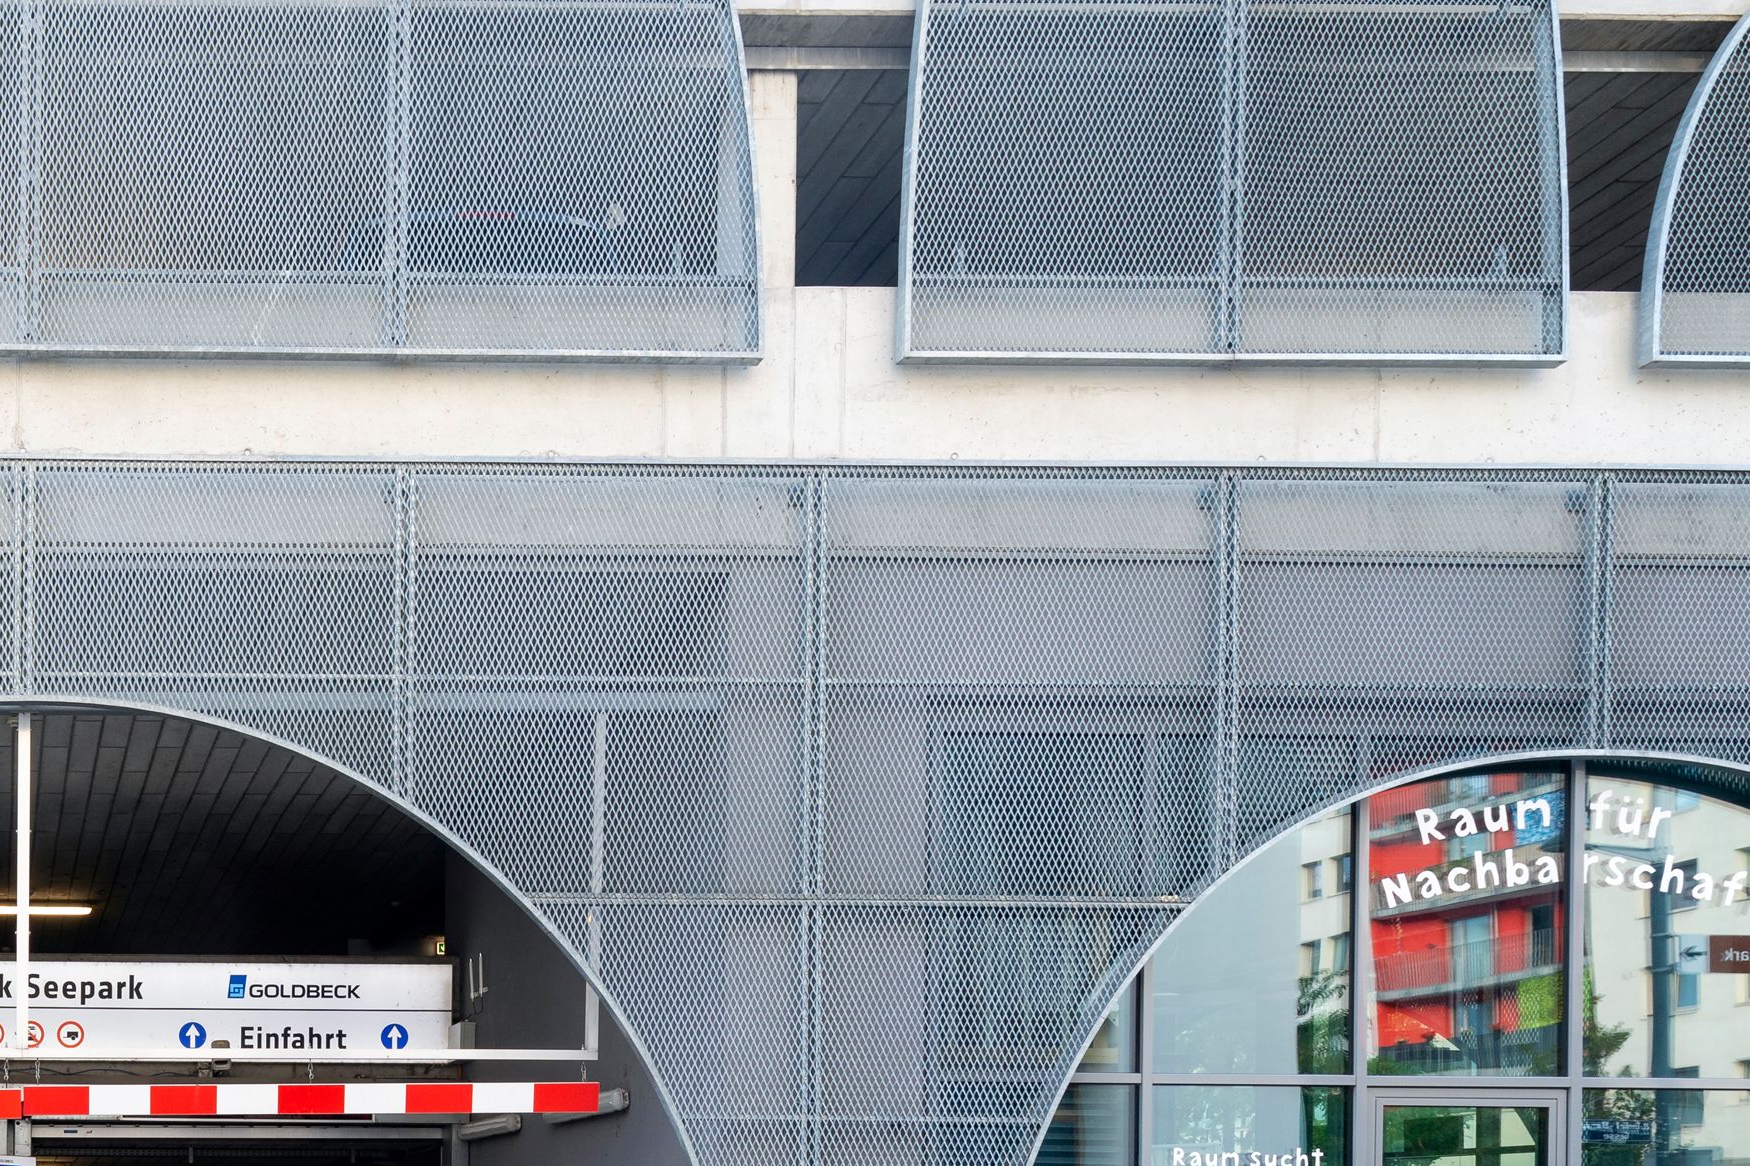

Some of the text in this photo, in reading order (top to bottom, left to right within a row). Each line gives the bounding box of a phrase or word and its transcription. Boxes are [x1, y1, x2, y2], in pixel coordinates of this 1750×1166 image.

[1415, 789, 1672, 846] Raum für
[28, 973, 144, 1005] Seepark
[249, 984, 361, 999] GOLDBECK
[240, 1025, 347, 1050] Einfahrt
